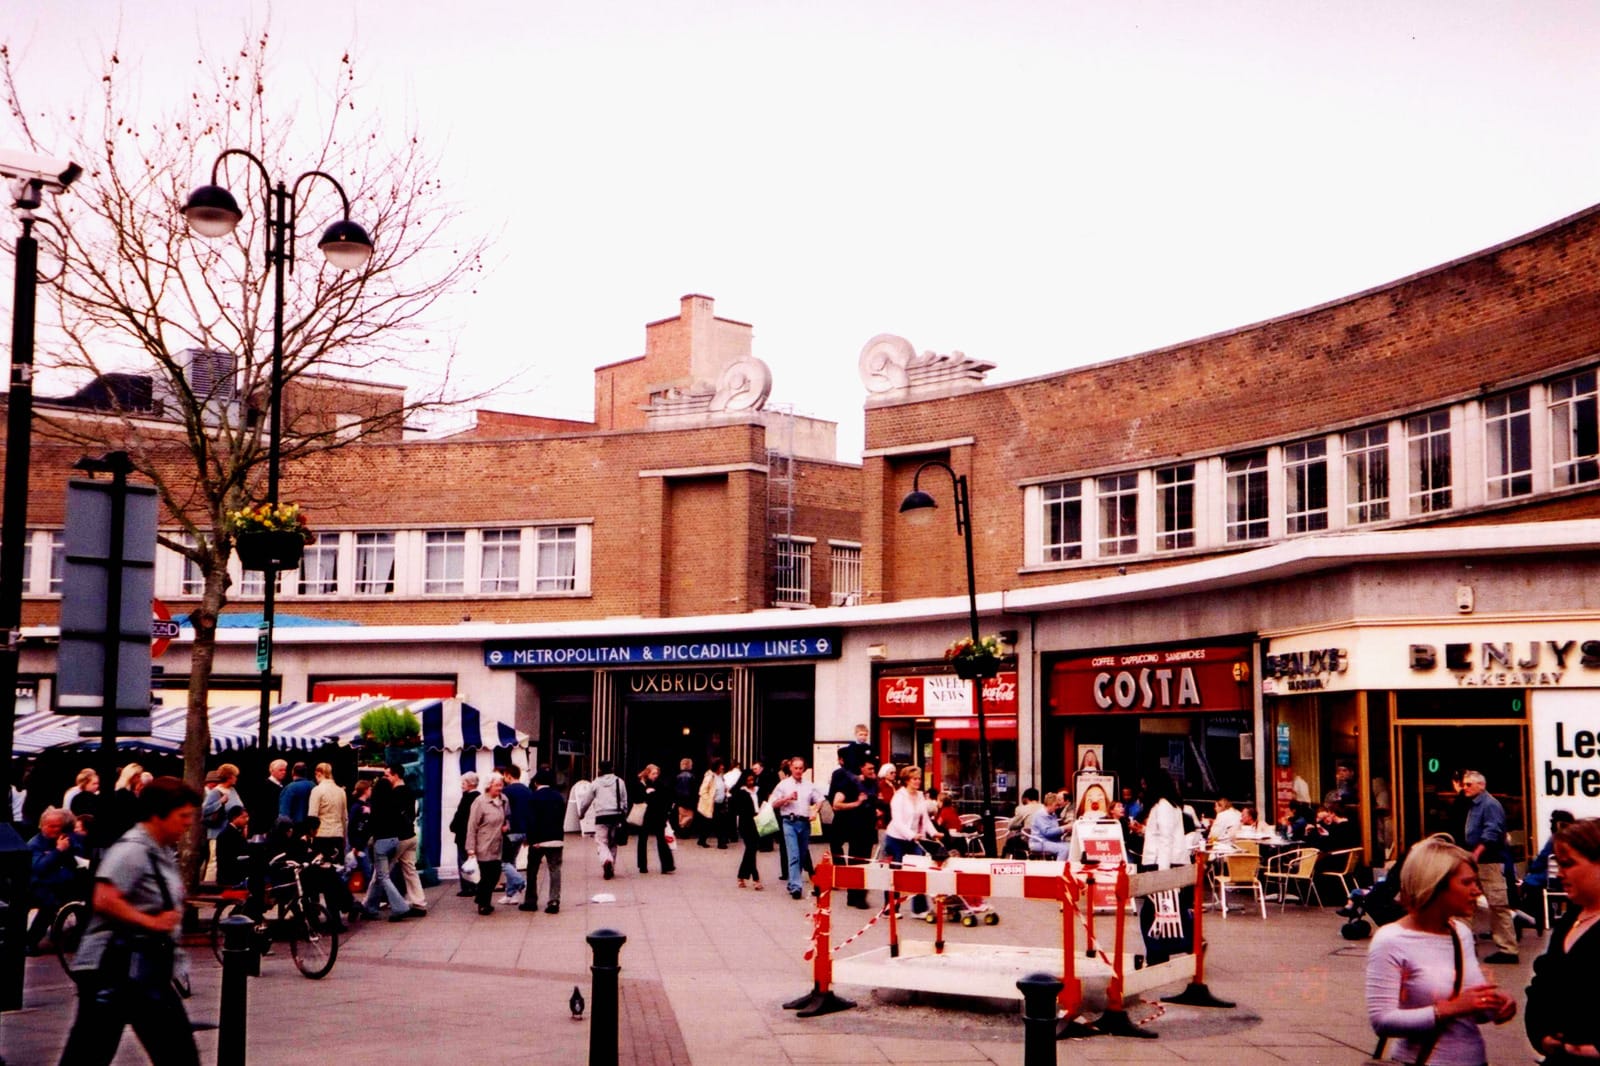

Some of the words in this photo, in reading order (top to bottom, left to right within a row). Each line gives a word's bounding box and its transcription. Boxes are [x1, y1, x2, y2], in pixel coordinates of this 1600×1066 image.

[513, 647, 631, 663] METROPOLITAN
[642, 646, 653, 660] &
[663, 642, 751, 659] PICCADILLY
[764, 639, 808, 656] LINES
[1092, 656, 1116, 667] COFFEE
[1120, 653, 1160, 666] CAPPUCCINO
[1164, 649, 1206, 662] SANDWICHES
[1409, 640, 1600, 670] BENJYS
[631, 671, 734, 692] UXBRIDGE
[1093, 667, 1200, 709] COSTA
[1454, 672, 1564, 686] TAKEAWAY
[1556, 722, 1600, 758] Le
